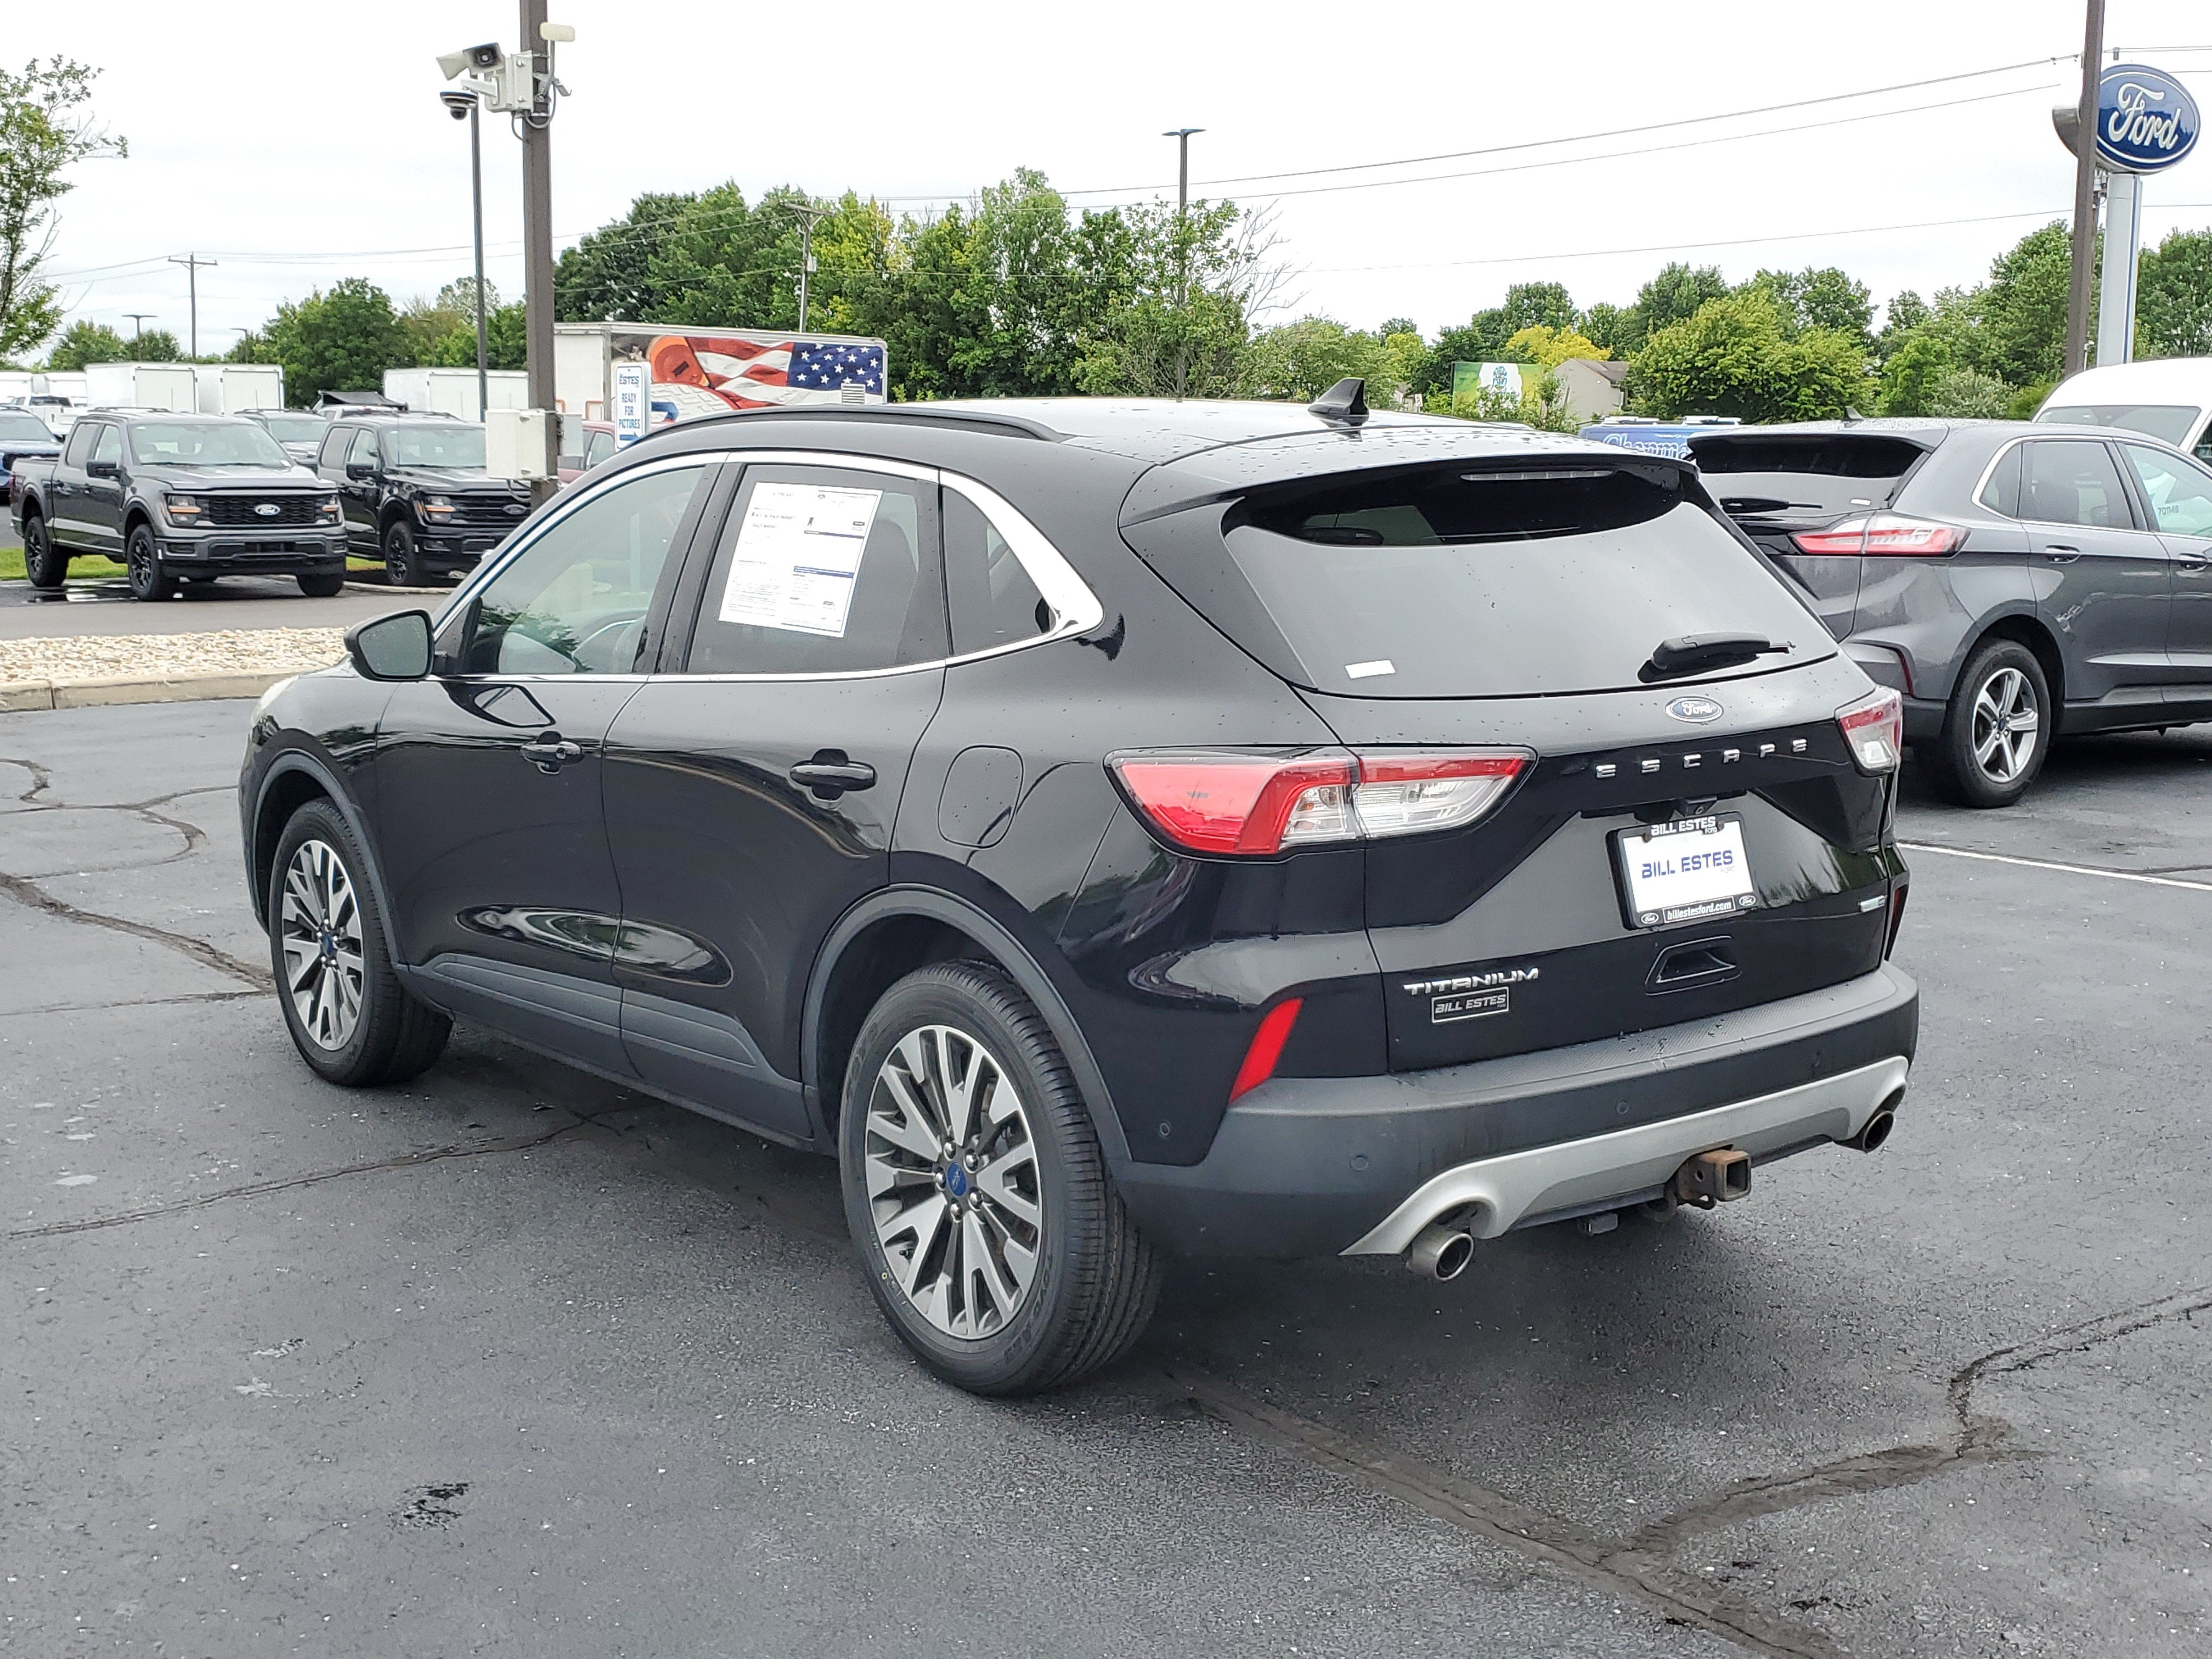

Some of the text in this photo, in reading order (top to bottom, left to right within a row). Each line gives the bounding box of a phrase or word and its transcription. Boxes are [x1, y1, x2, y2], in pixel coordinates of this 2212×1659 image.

[2108, 83, 2182, 150] Ford
[622, 393, 636, 403] READY
[624, 405, 634, 416] FOR
[619, 419, 640, 429] PICTURES
[1681, 701, 1712, 715] Ford
[1596, 738, 1807, 778] ESCAPE
[1651, 816, 1716, 836] BILL ESTES
[1642, 850, 1733, 878] BILL ESTES
[1667, 901, 1731, 920] billestesford.com
[1403, 967, 1539, 995] TITANIUM
[1435, 1001, 1463, 1013] BILL
[1465, 994, 1506, 1009] ESTES
